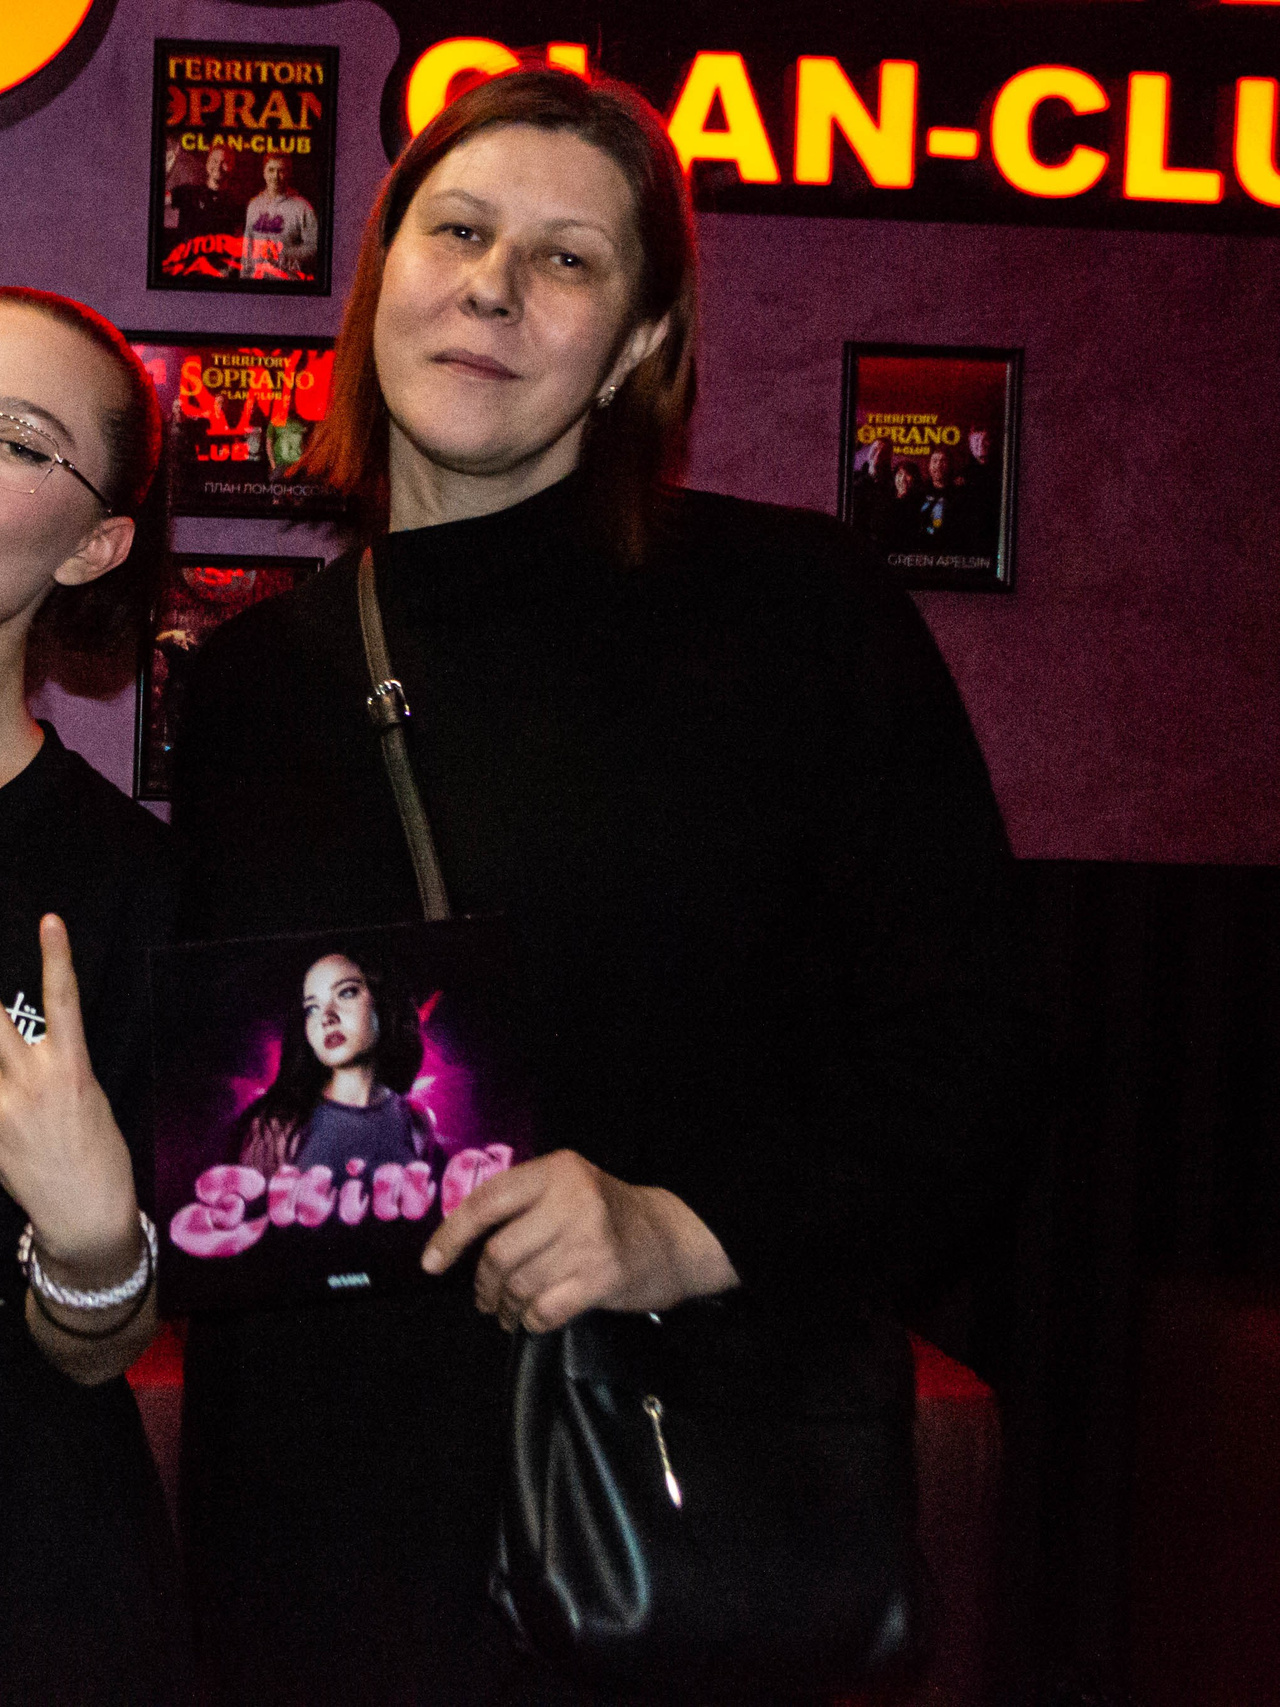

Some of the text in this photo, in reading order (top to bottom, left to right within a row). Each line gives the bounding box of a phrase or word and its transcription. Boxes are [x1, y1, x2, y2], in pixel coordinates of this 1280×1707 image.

[169, 56, 324, 85] TERRITORY
[407, 36, 1280, 207] CAN-CL
[181, 132, 311, 154] CLAN-CLUB
[212, 353, 291, 367] TERRITORY
[180, 360, 315, 396] SOPRANO
[204, 481, 336, 498] ПЛАН ЛОМОНОСО
[887, 553, 991, 569] GREEN APELSIN
